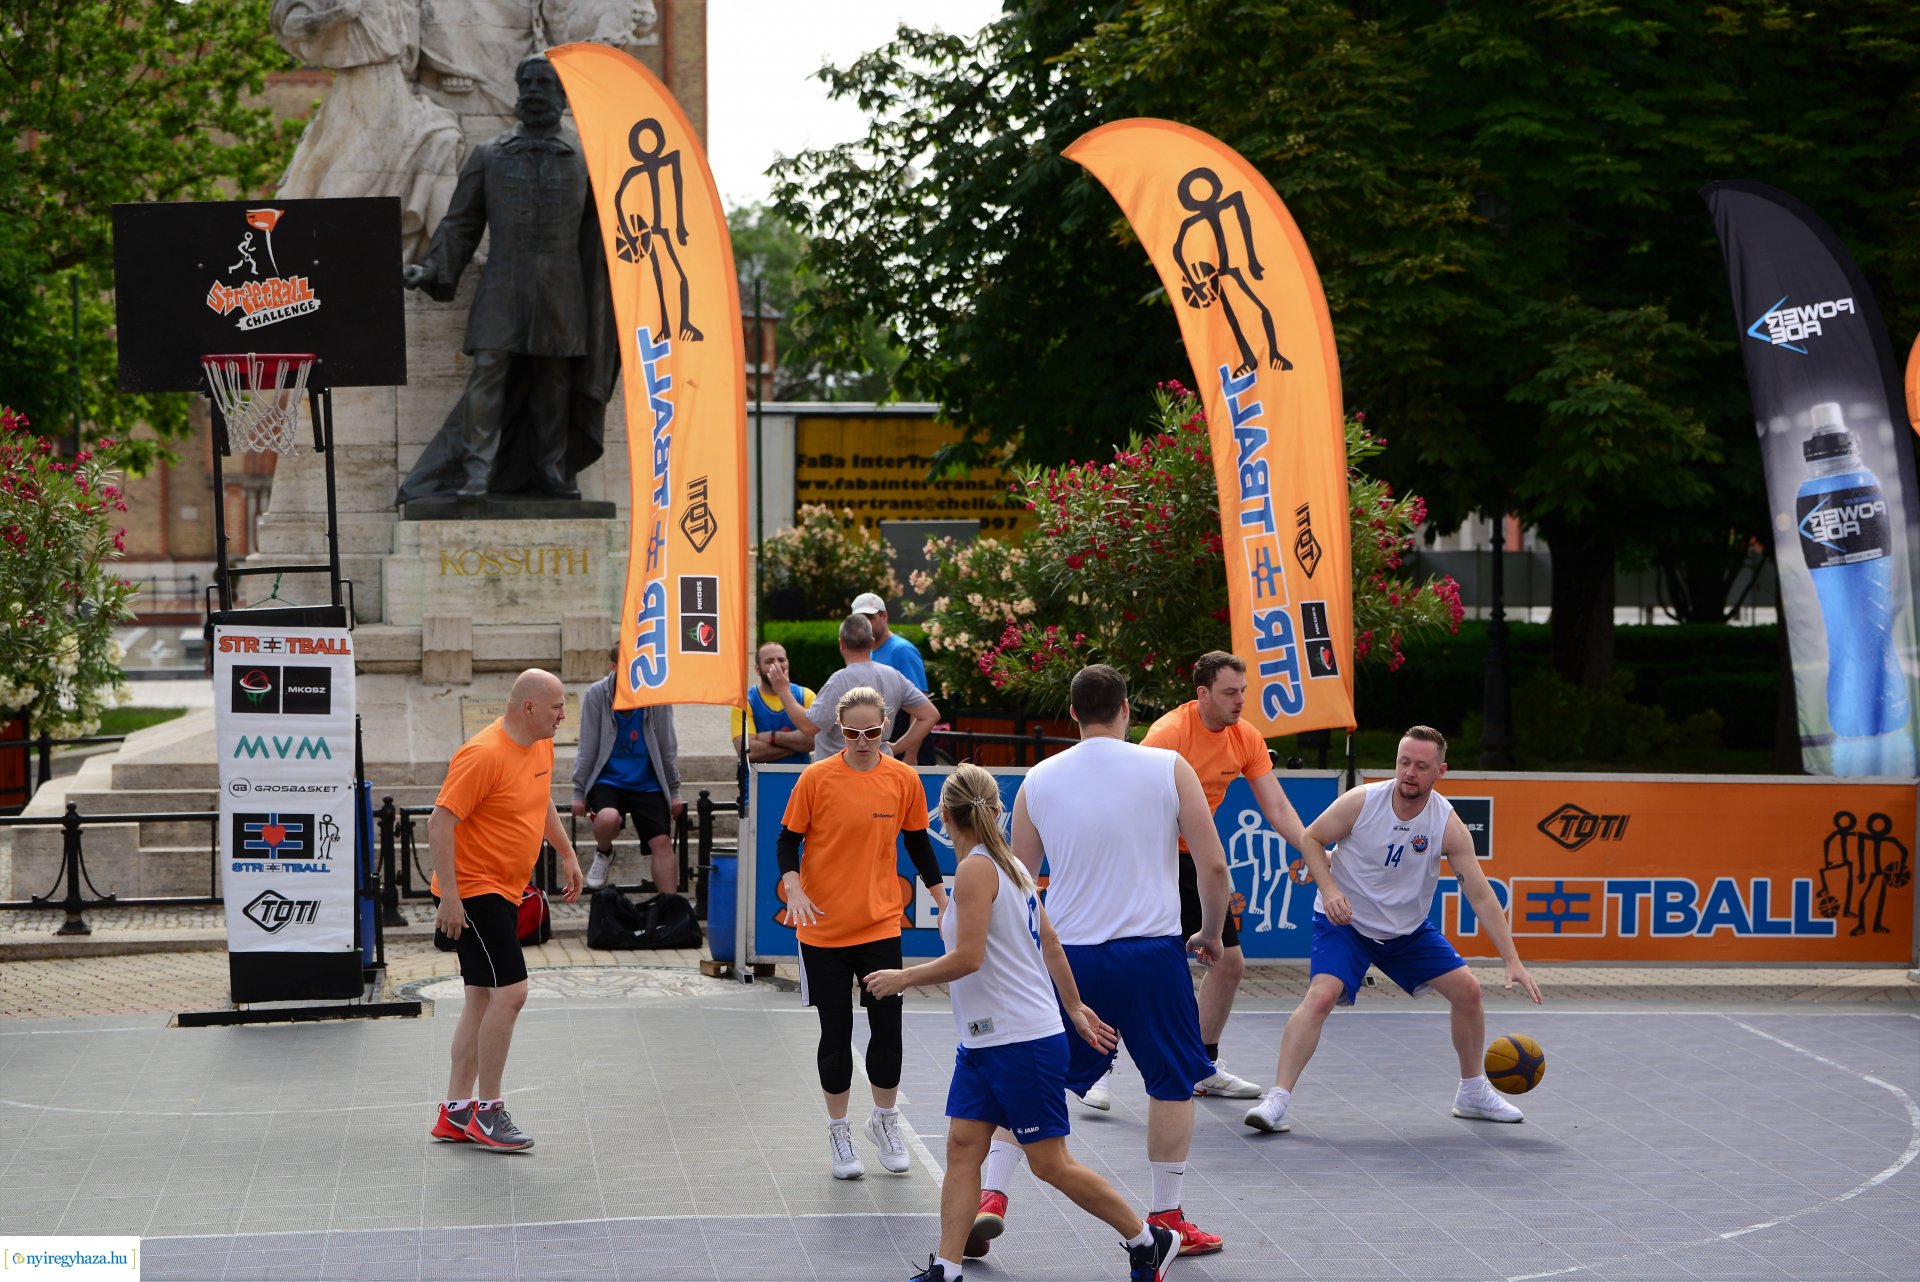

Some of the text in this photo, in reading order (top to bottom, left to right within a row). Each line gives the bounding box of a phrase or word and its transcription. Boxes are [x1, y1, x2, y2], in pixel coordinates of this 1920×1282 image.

[246, 300, 316, 328] CHALLENGE
[440, 548, 588, 577] KOSSUTH
[219, 635, 351, 655] STREETBALL
[287, 686, 326, 694] MKOSZ
[233, 735, 332, 760] MVM
[254, 785, 339, 793] GROSBASKET
[1557, 814, 1631, 841] TOTI
[231, 862, 331, 873] STREETBALL
[1384, 843, 1405, 868] 14
[261, 900, 321, 924] TOTI
[1023, 1126, 1040, 1134] JAKO
